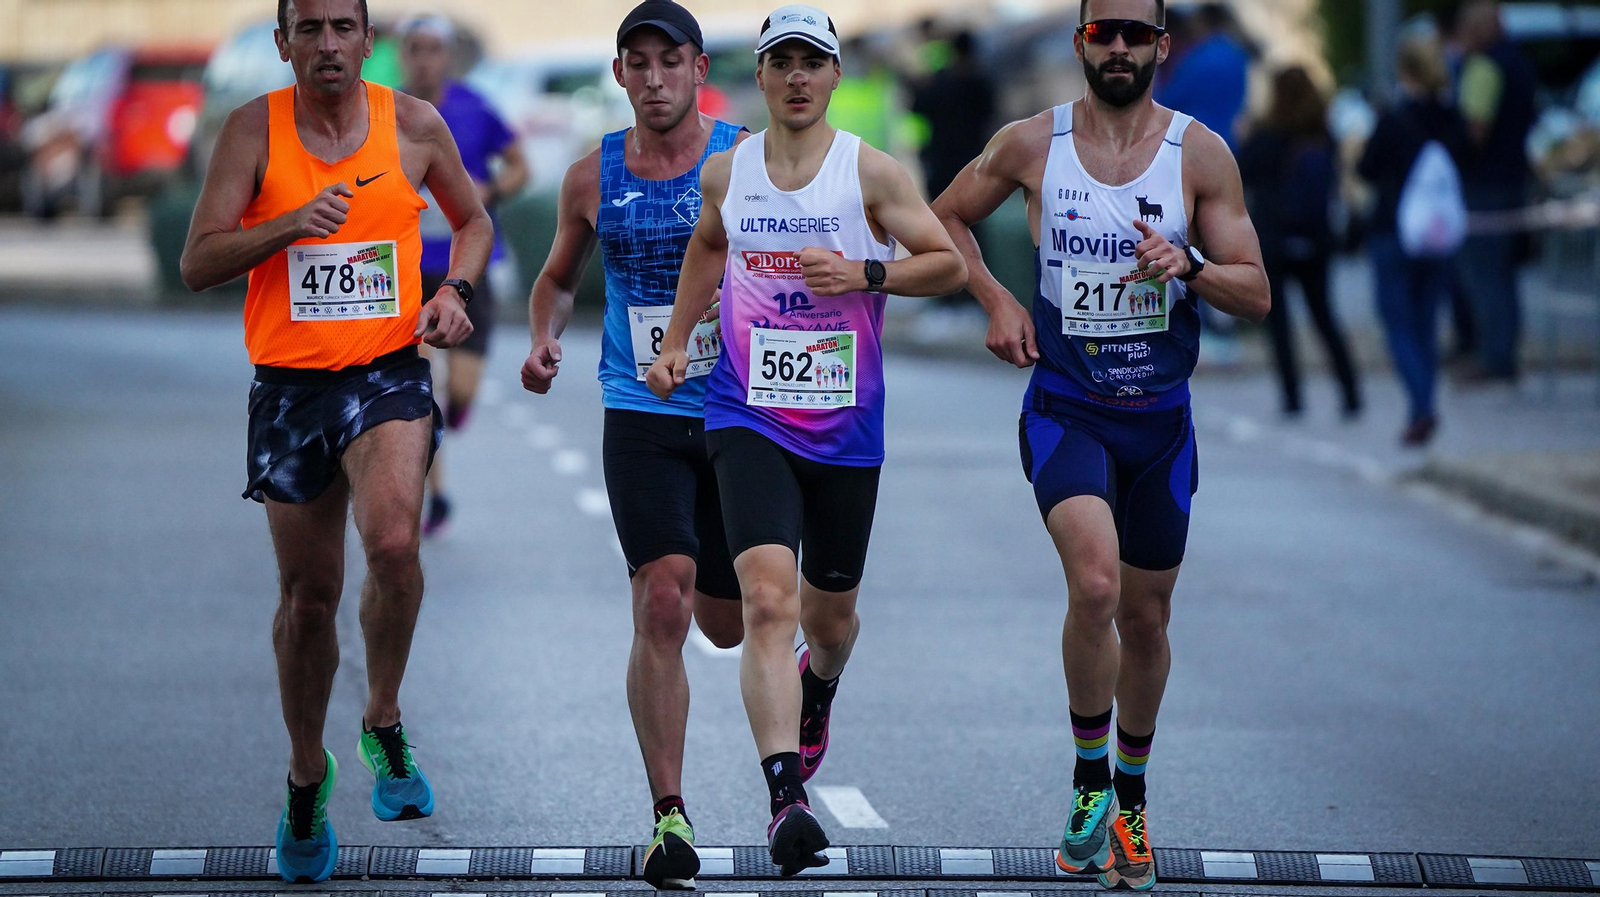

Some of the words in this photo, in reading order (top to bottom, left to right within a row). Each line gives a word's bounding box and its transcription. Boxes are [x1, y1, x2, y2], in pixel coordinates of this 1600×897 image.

[1058, 188, 1090, 202] GOBIK
[740, 216, 840, 233] ULTRASERIES
[1051, 228, 1142, 263] Movije
[347, 250, 378, 264] MARATÓN
[762, 253, 803, 268] Dora
[301, 264, 356, 294] 478
[772, 291, 816, 316] 10
[1073, 281, 1126, 312] 217
[789, 310, 842, 319] Aniversario
[806, 340, 838, 353] MARATÓN
[1102, 341, 1147, 352] FITNESS
[1128, 350, 1148, 361] plus
[761, 350, 813, 382] 562
